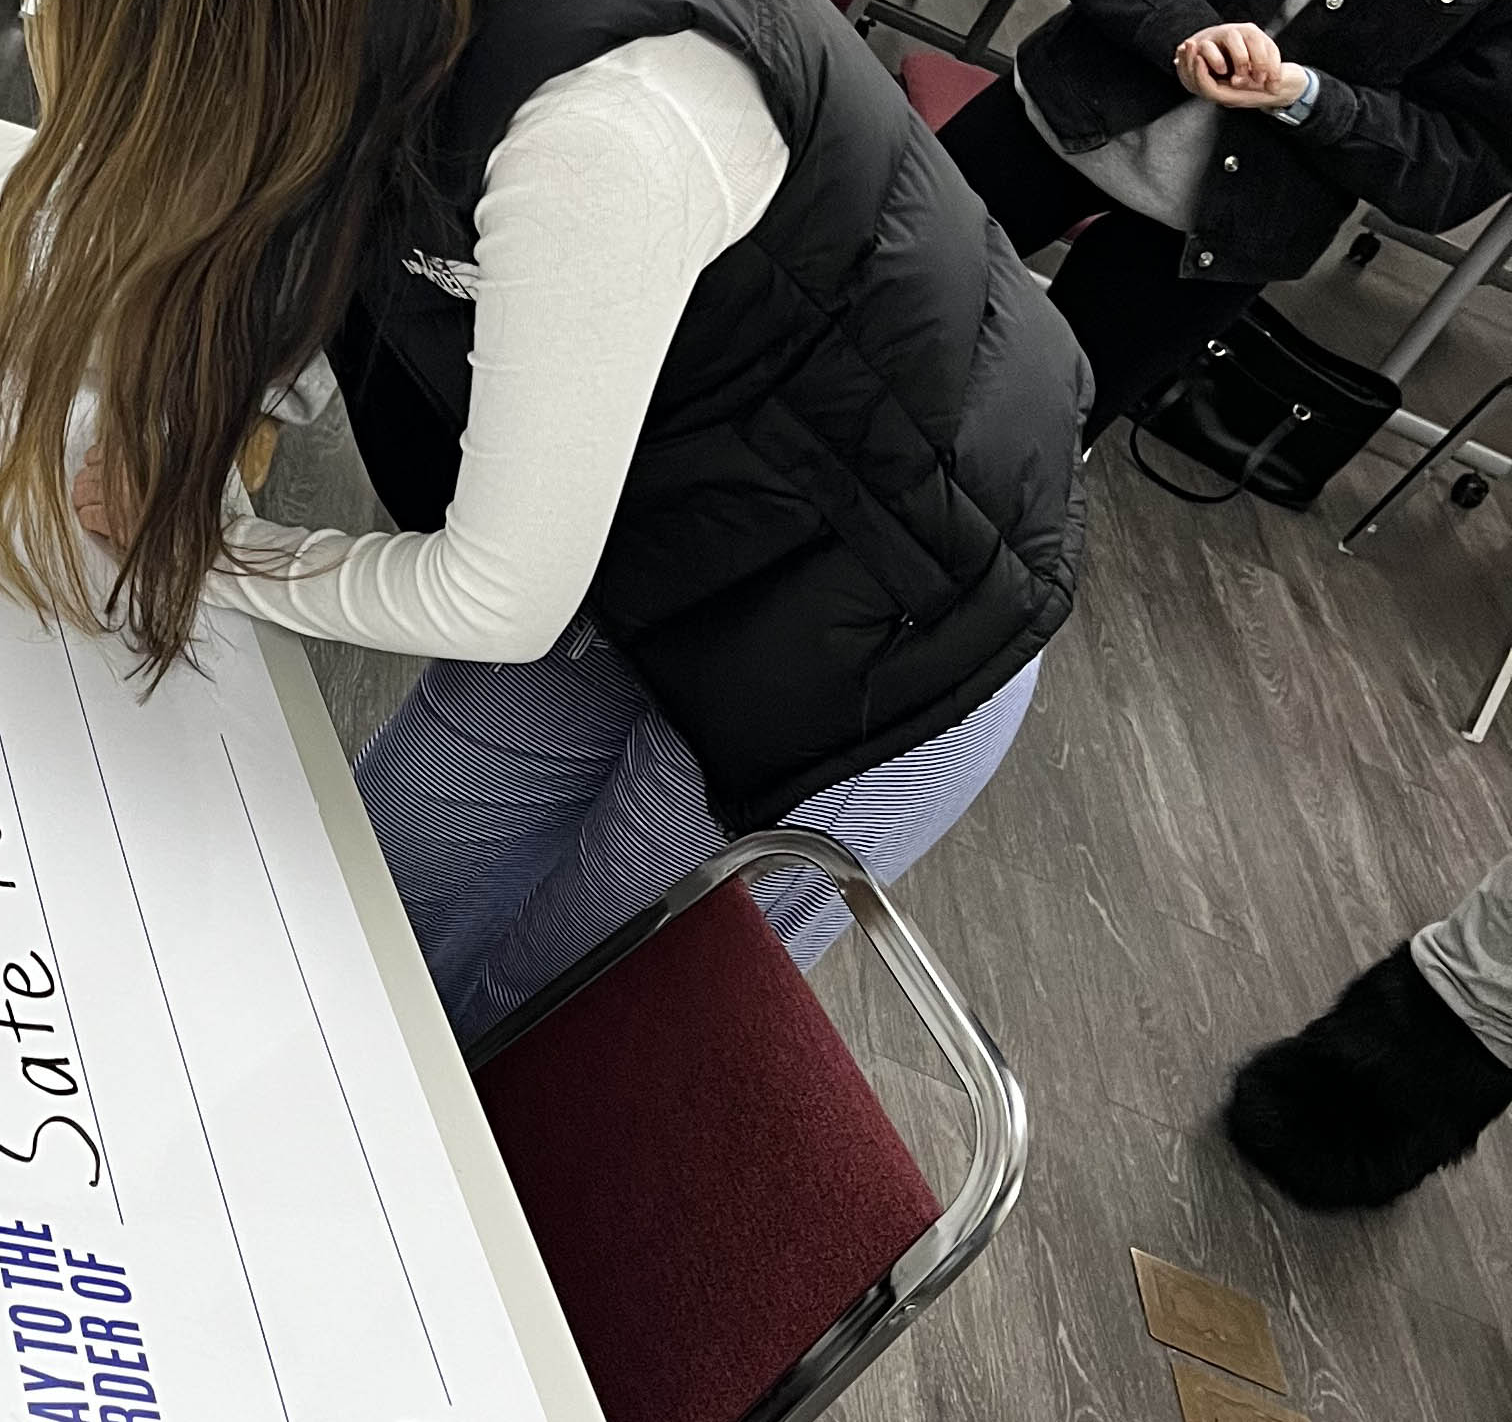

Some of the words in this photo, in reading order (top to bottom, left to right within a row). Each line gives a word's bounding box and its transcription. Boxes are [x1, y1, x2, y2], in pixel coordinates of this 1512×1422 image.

[62, 1248, 133, 1304] OF
[8, 1304, 79, 1355] TO
[19, 1363, 90, 1422] AY
[79, 1315, 162, 1422] RDER
